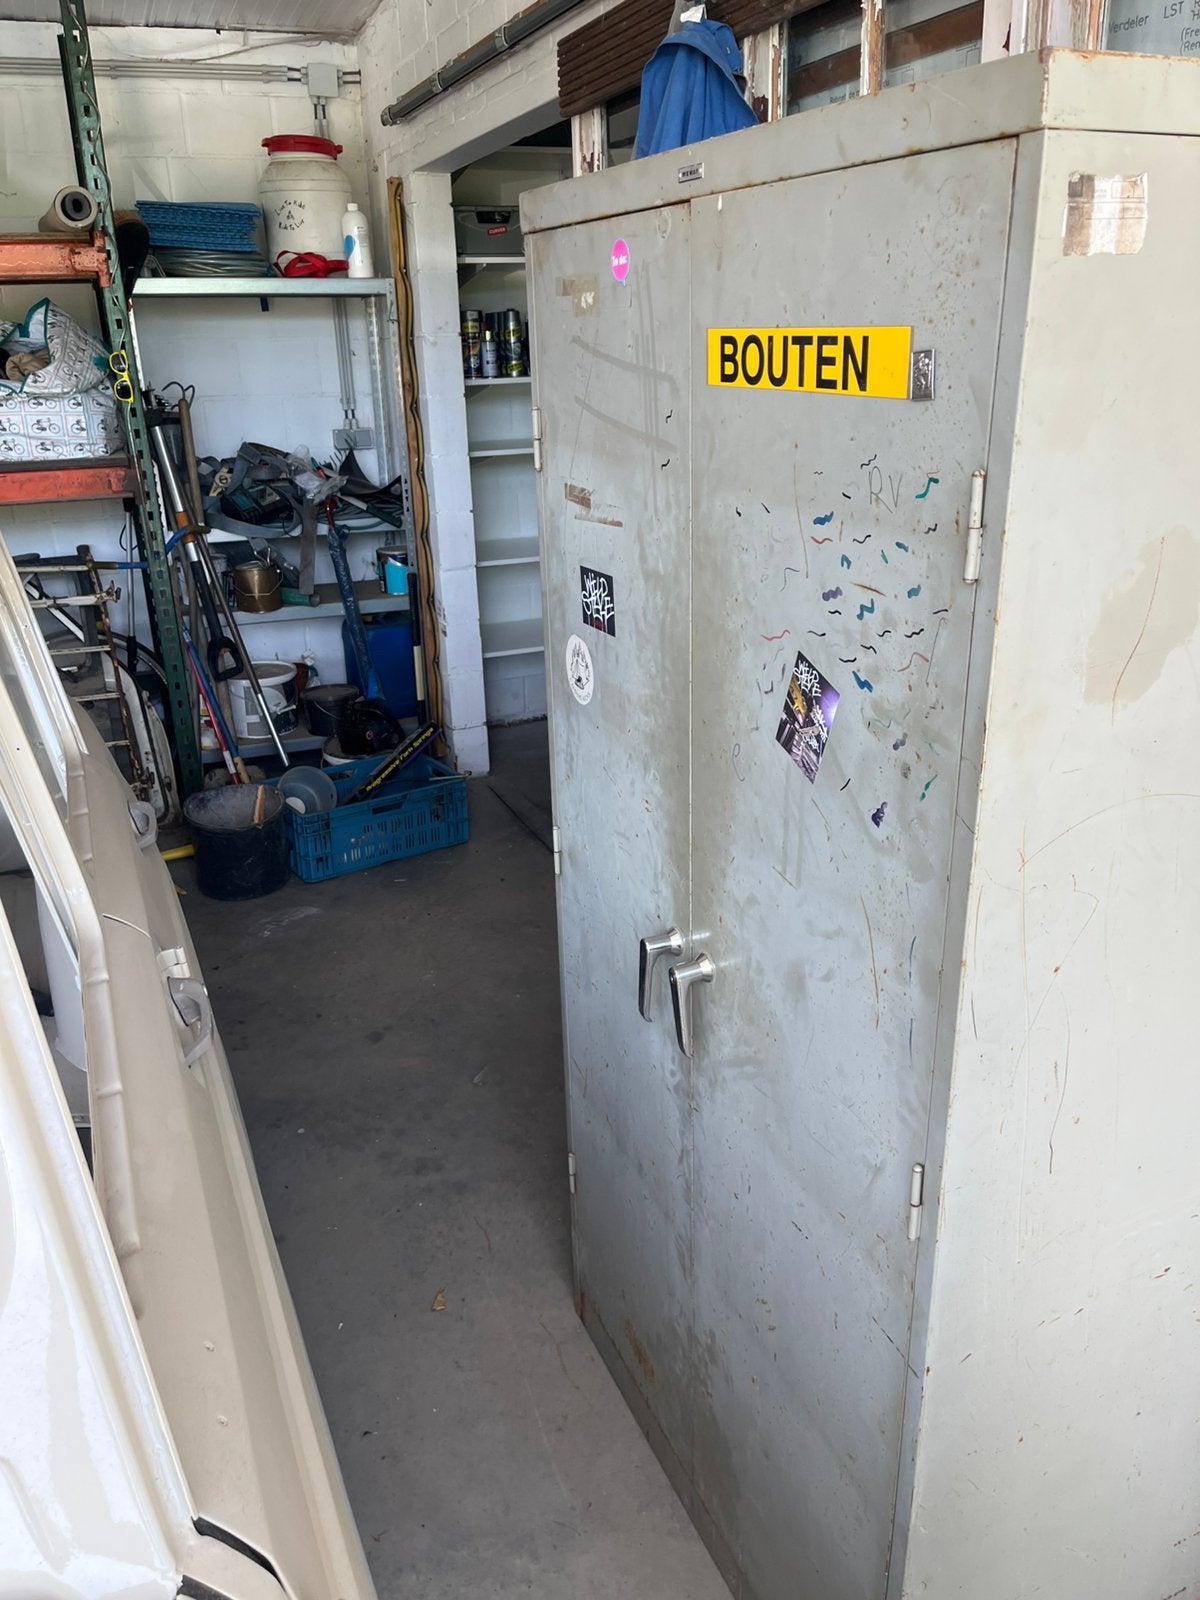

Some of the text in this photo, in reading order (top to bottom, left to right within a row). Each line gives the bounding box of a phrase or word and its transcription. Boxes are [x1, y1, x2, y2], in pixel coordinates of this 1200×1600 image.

[1109, 14, 1150, 34] Verdeler
[1163, 1, 1185, 19] LST
[719, 334, 870, 393] BOUTEN
[867, 464, 904, 514] RV
